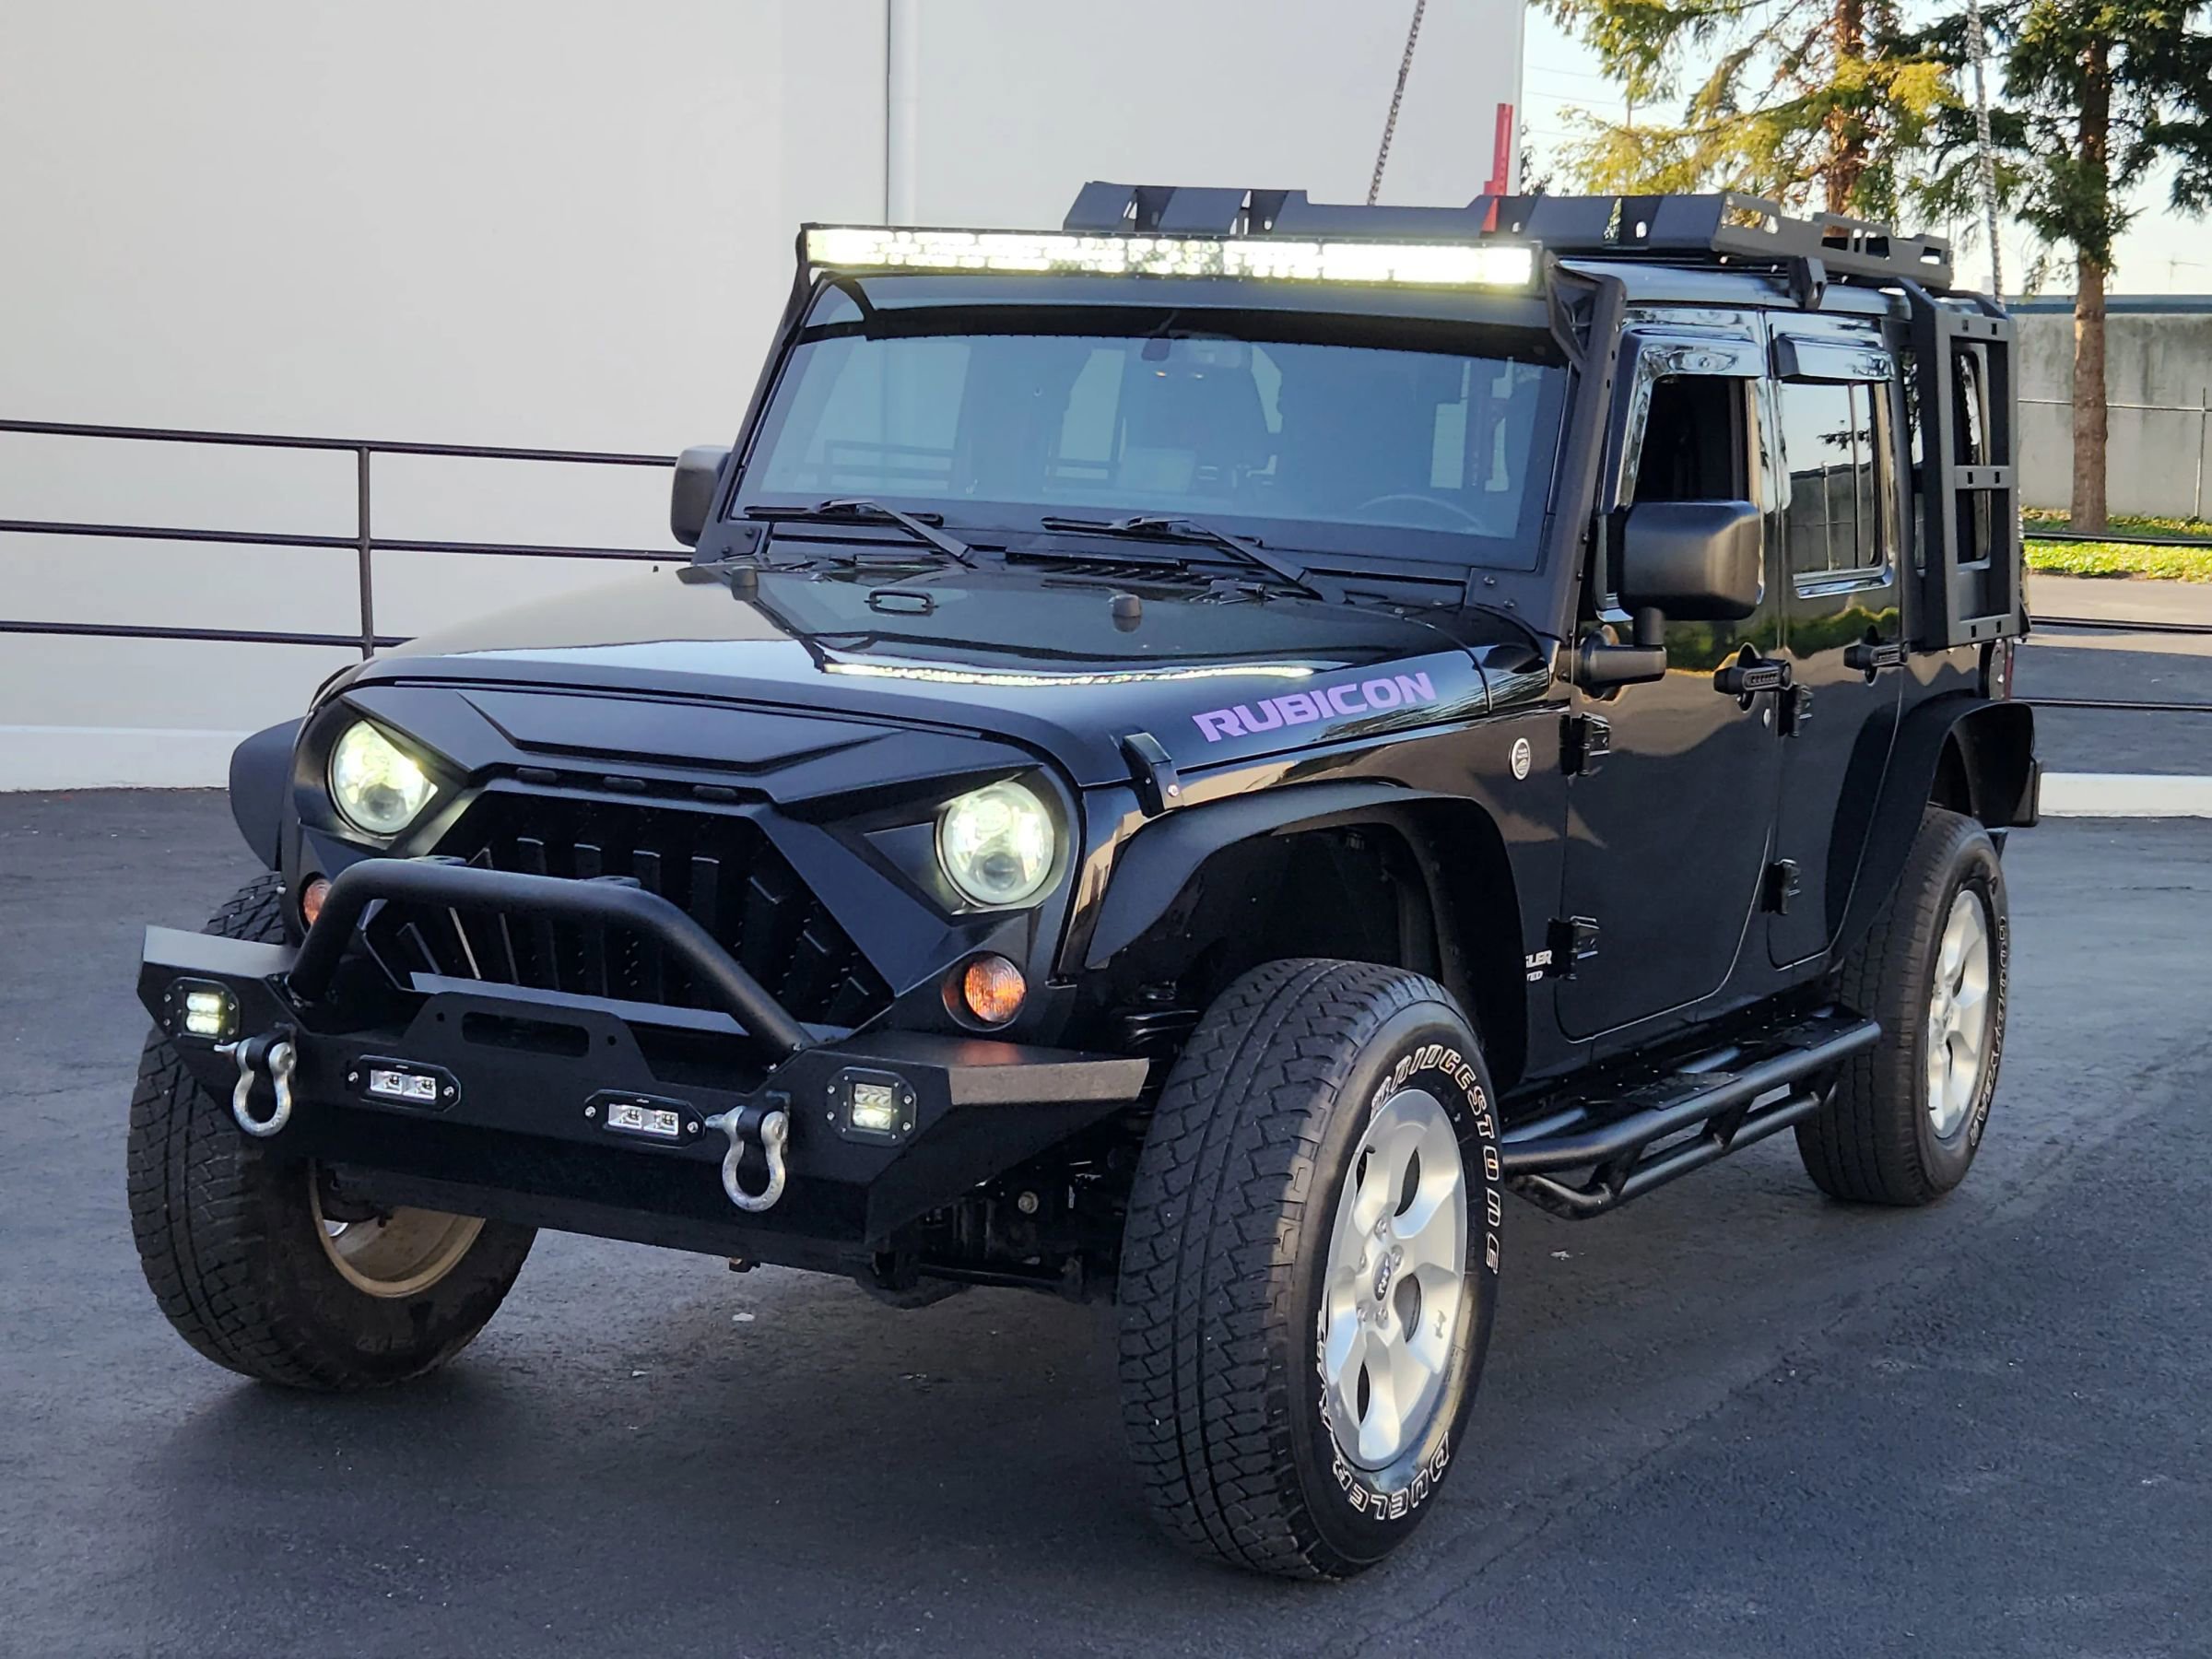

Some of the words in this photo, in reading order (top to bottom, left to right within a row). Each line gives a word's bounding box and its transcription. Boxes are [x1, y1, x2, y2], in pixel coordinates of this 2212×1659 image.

[1192, 672, 1437, 743] RUBICON
[1370, 1043, 1501, 1276] BRIDGESTONE
[1333, 1430, 1451, 1521] DUELER
